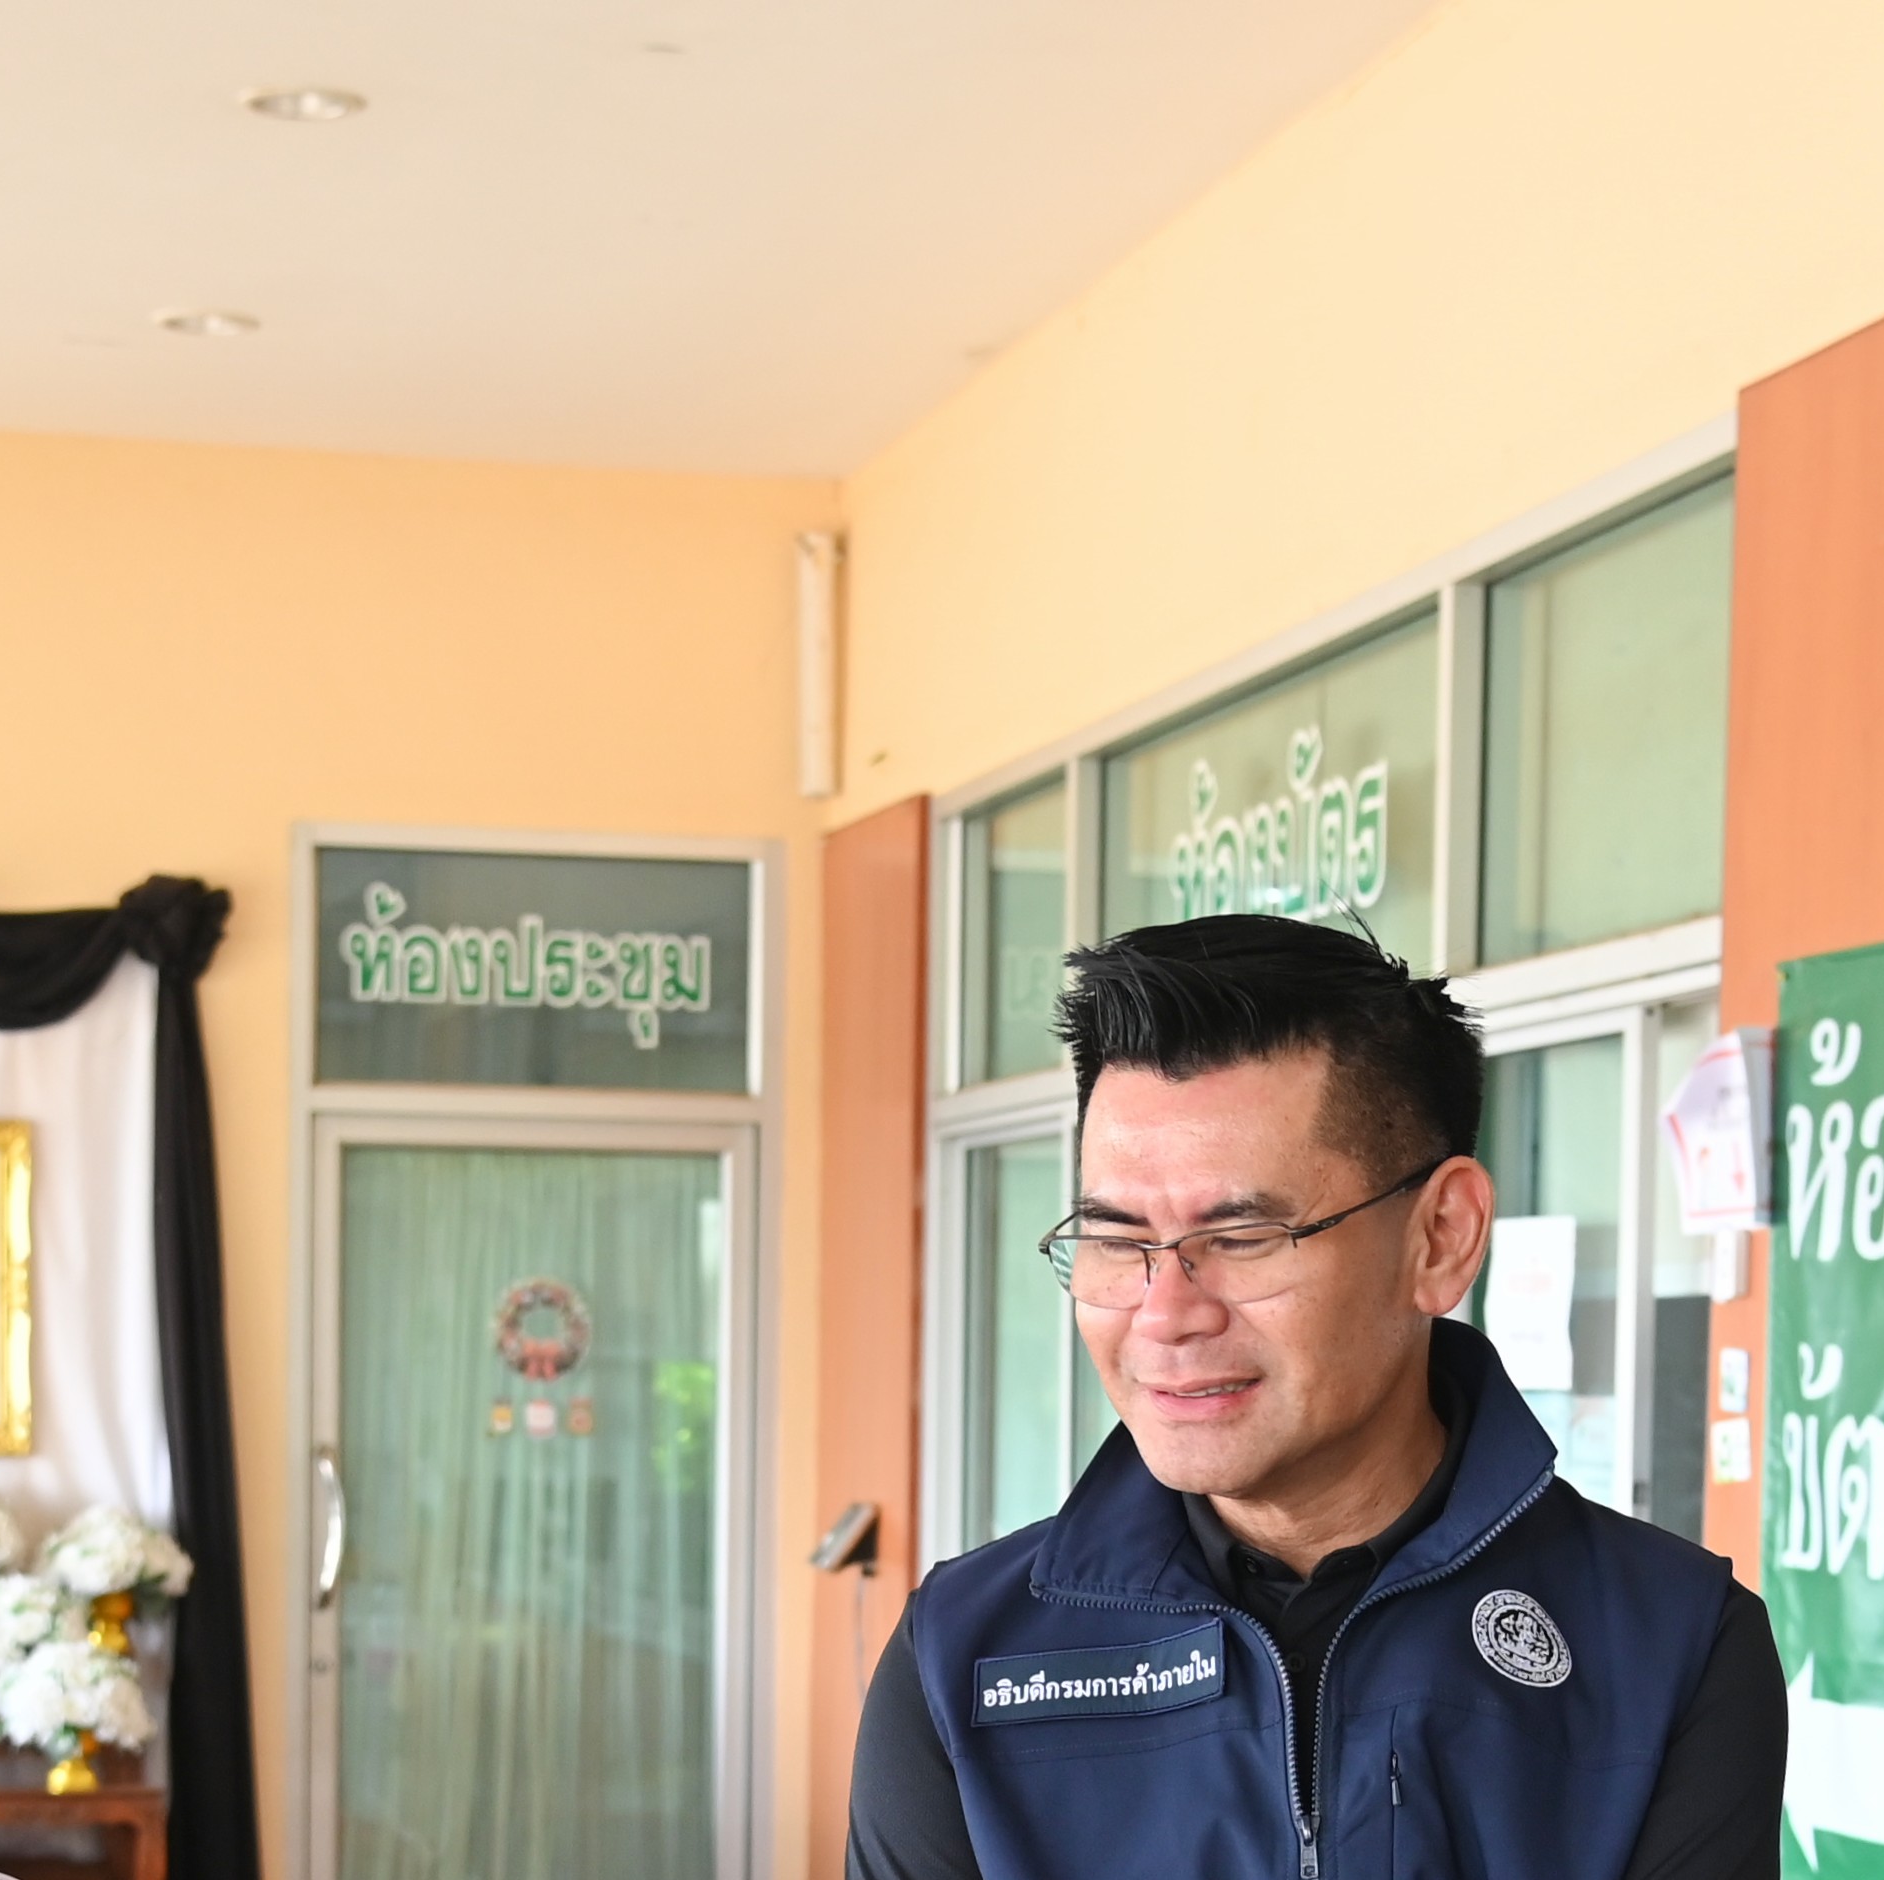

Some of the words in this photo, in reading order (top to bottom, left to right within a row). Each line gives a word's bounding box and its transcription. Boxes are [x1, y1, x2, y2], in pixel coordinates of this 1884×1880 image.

[341, 882, 710, 1049] ห้องประชุม
[983, 1650, 1216, 1708] อธิบดีกรมการค้าภายใน
